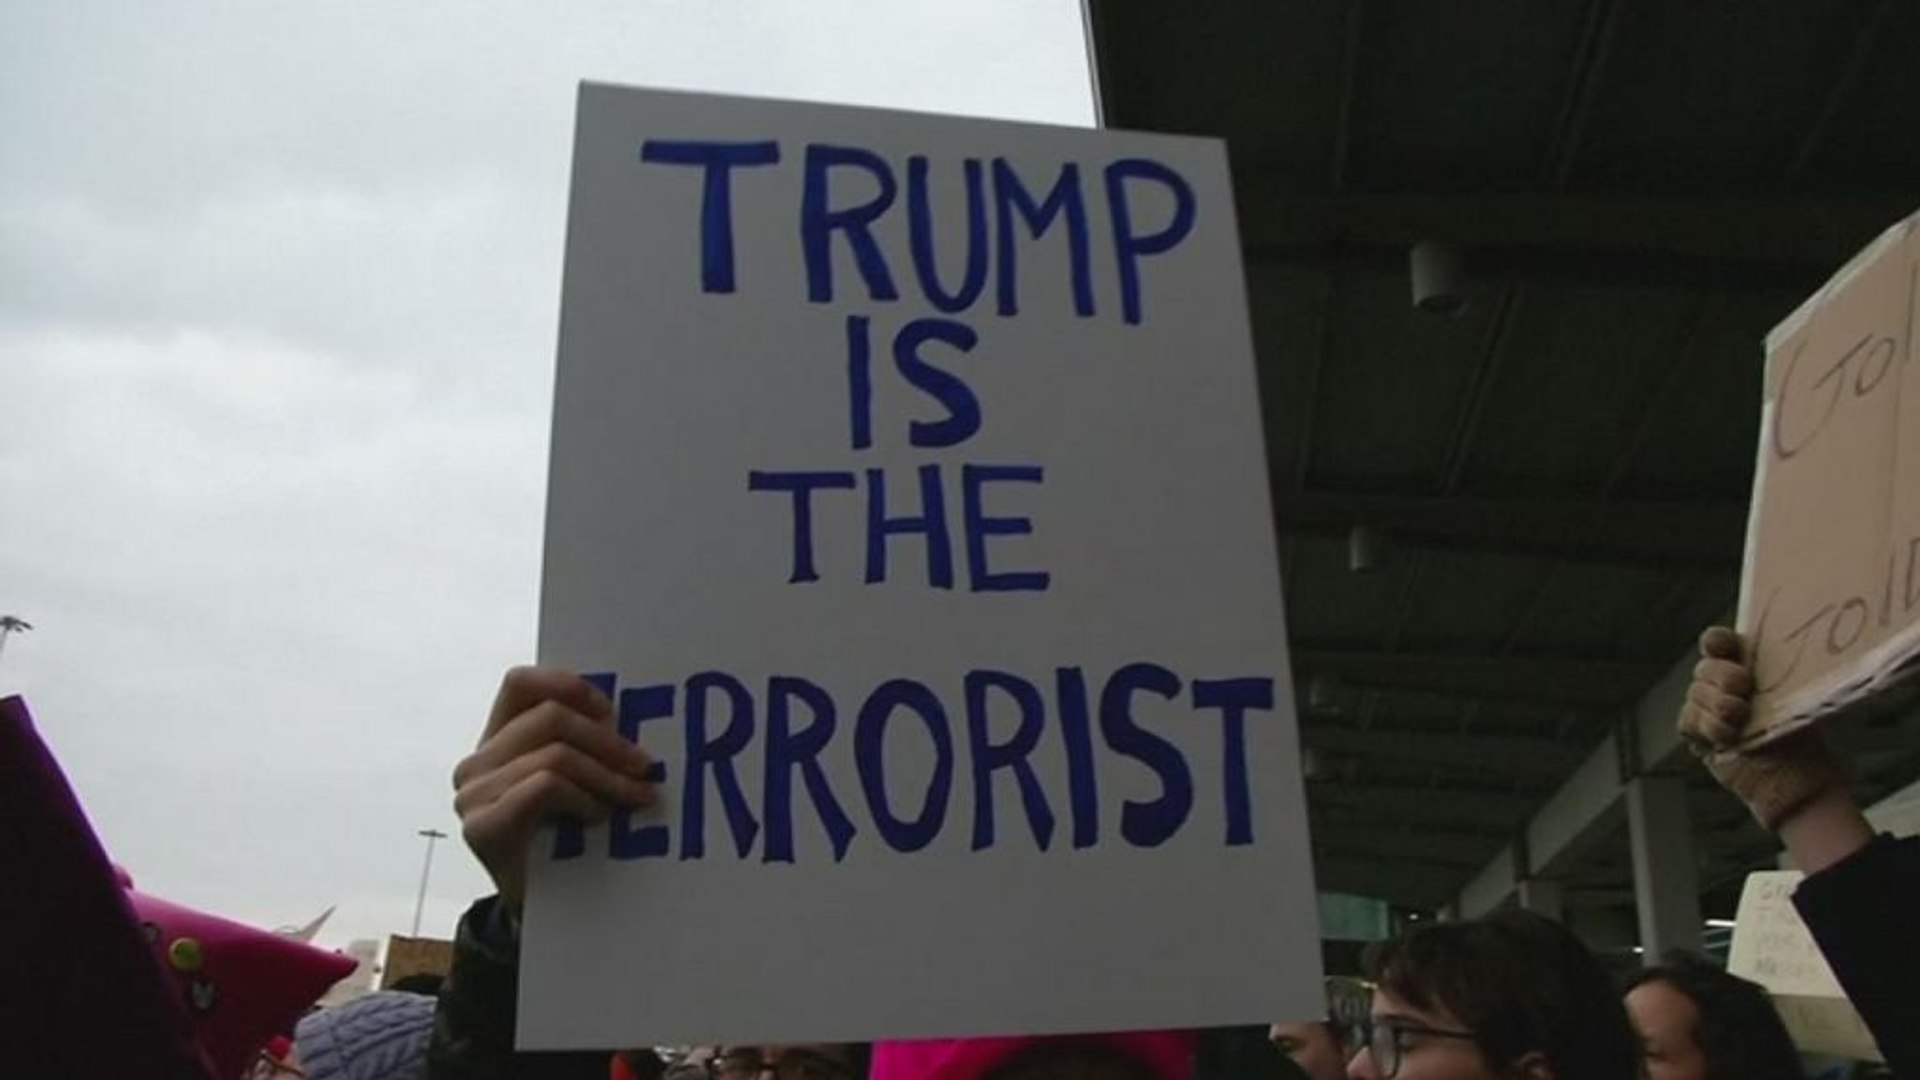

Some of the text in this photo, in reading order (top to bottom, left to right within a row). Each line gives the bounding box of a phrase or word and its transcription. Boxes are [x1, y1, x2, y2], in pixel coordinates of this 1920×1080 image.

[641, 139, 1196, 325] TRUMP
[848, 315, 982, 450] IS
[747, 464, 1051, 592] THE
